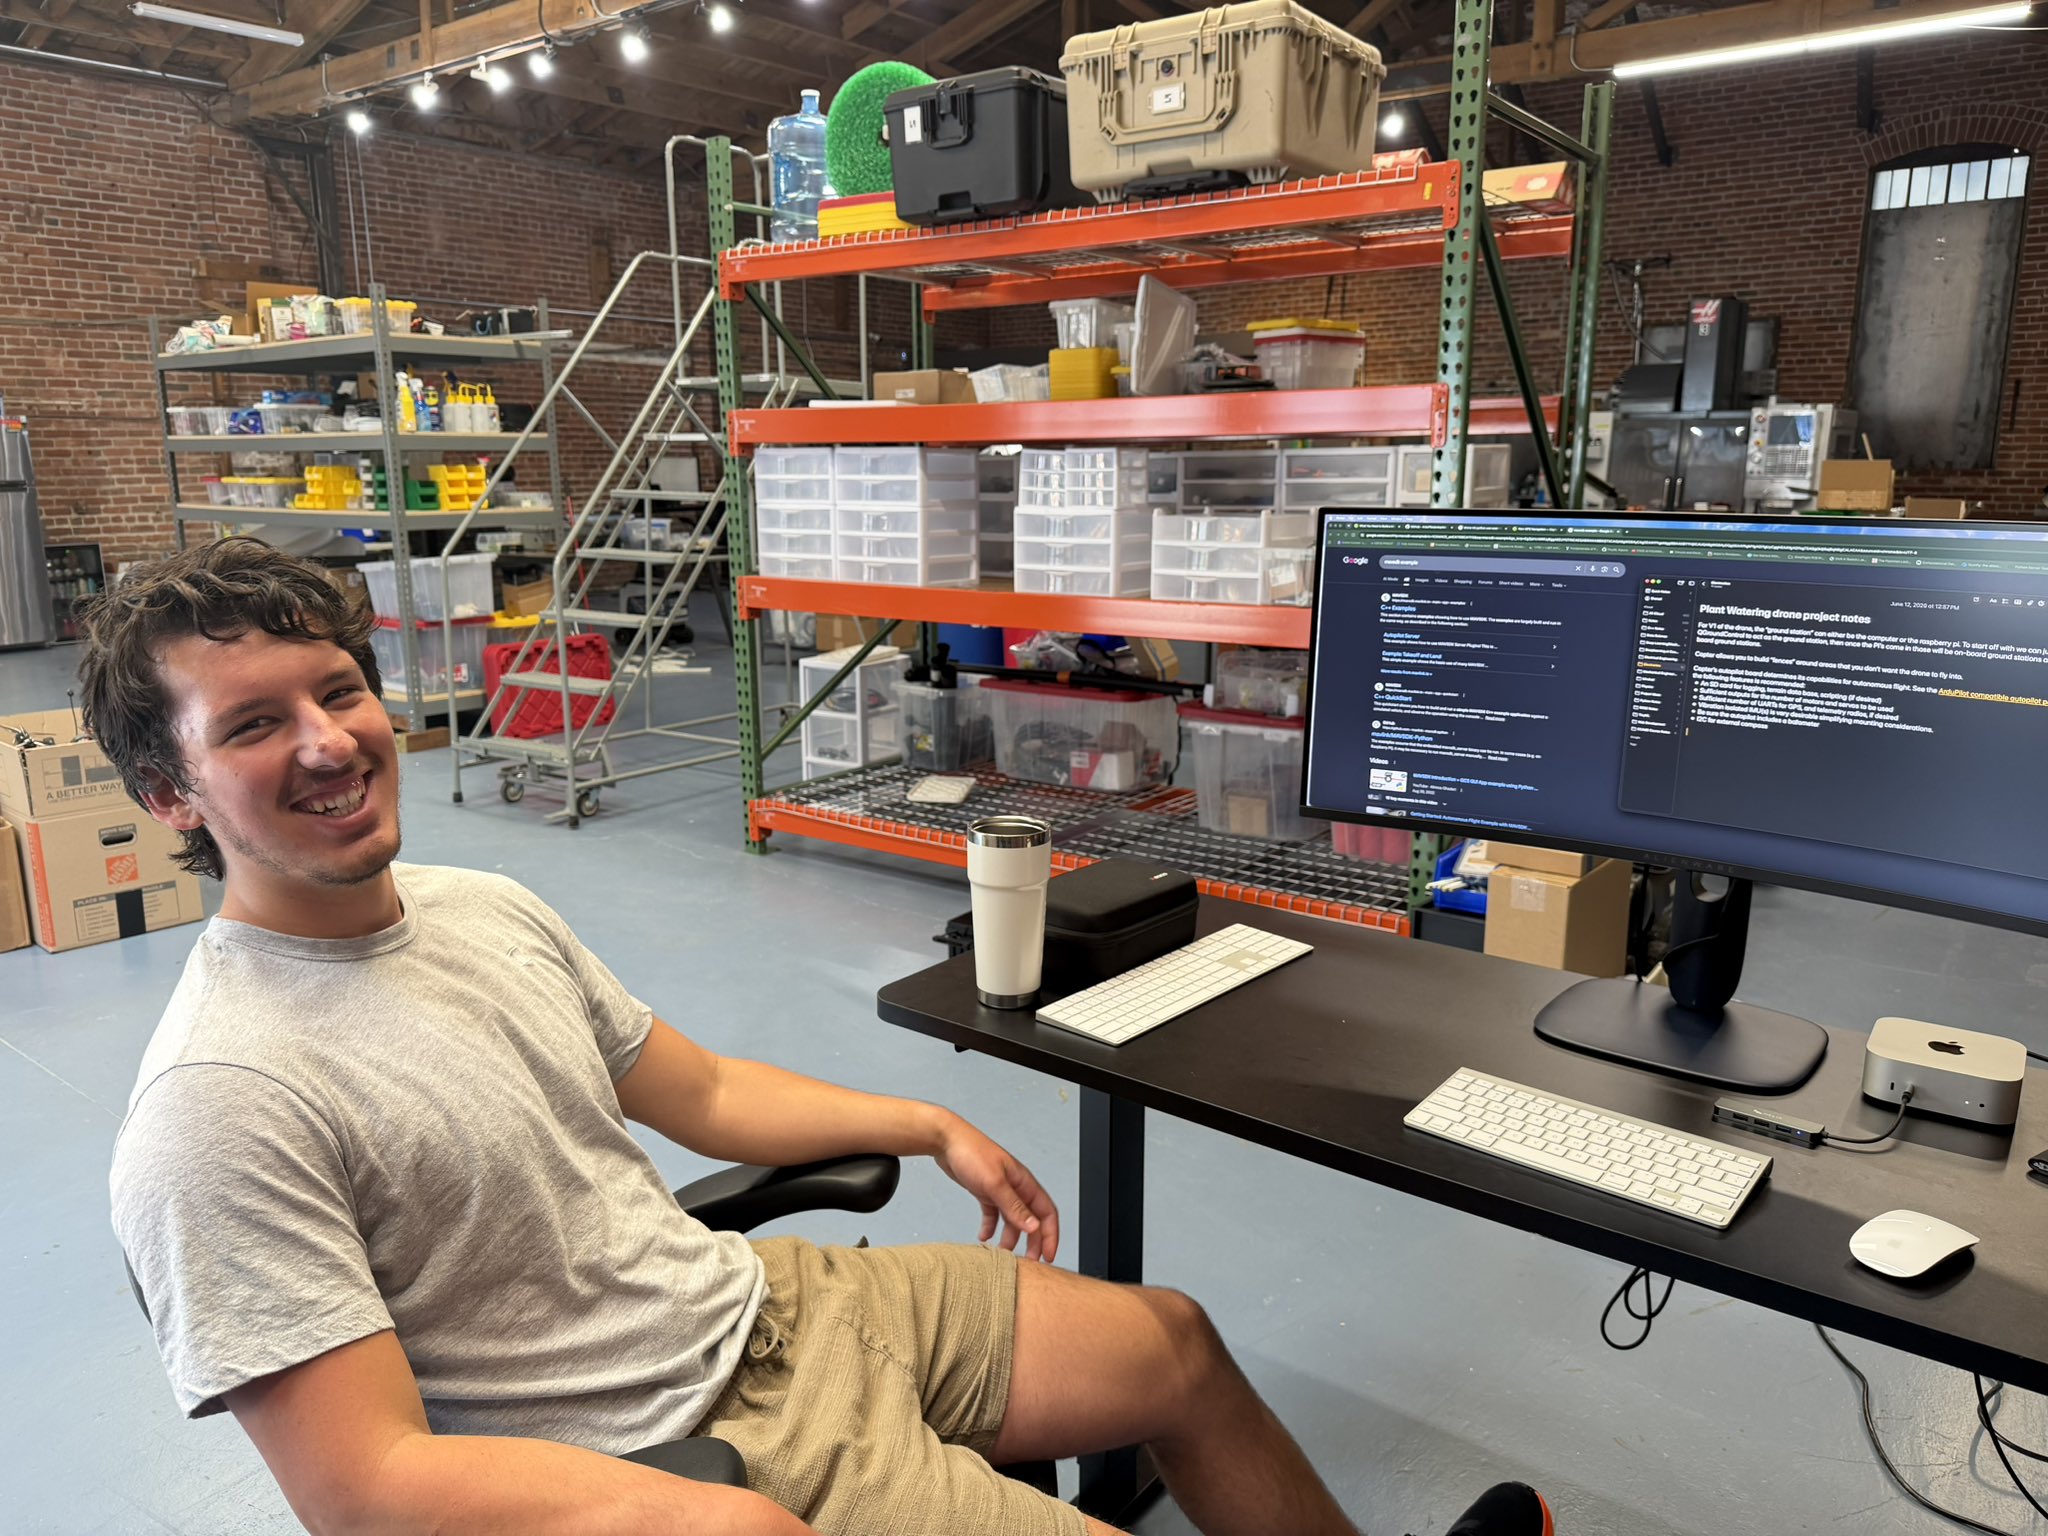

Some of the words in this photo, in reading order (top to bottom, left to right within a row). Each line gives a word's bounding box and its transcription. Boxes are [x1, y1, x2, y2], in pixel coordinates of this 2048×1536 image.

[1342, 556, 1369, 565] Google
[1700, 604, 1726, 614] Plant
[1726, 606, 1770, 619] Watering
[1772, 609, 1802, 619] drone
[1802, 611, 1840, 622] project
[1840, 615, 1872, 624] notes
[1919, 639, 1952, 648] raspberry
[1911, 669, 1930, 677] drone
[56, 785, 97, 798] BETTER
[99, 781, 122, 791] WAY
